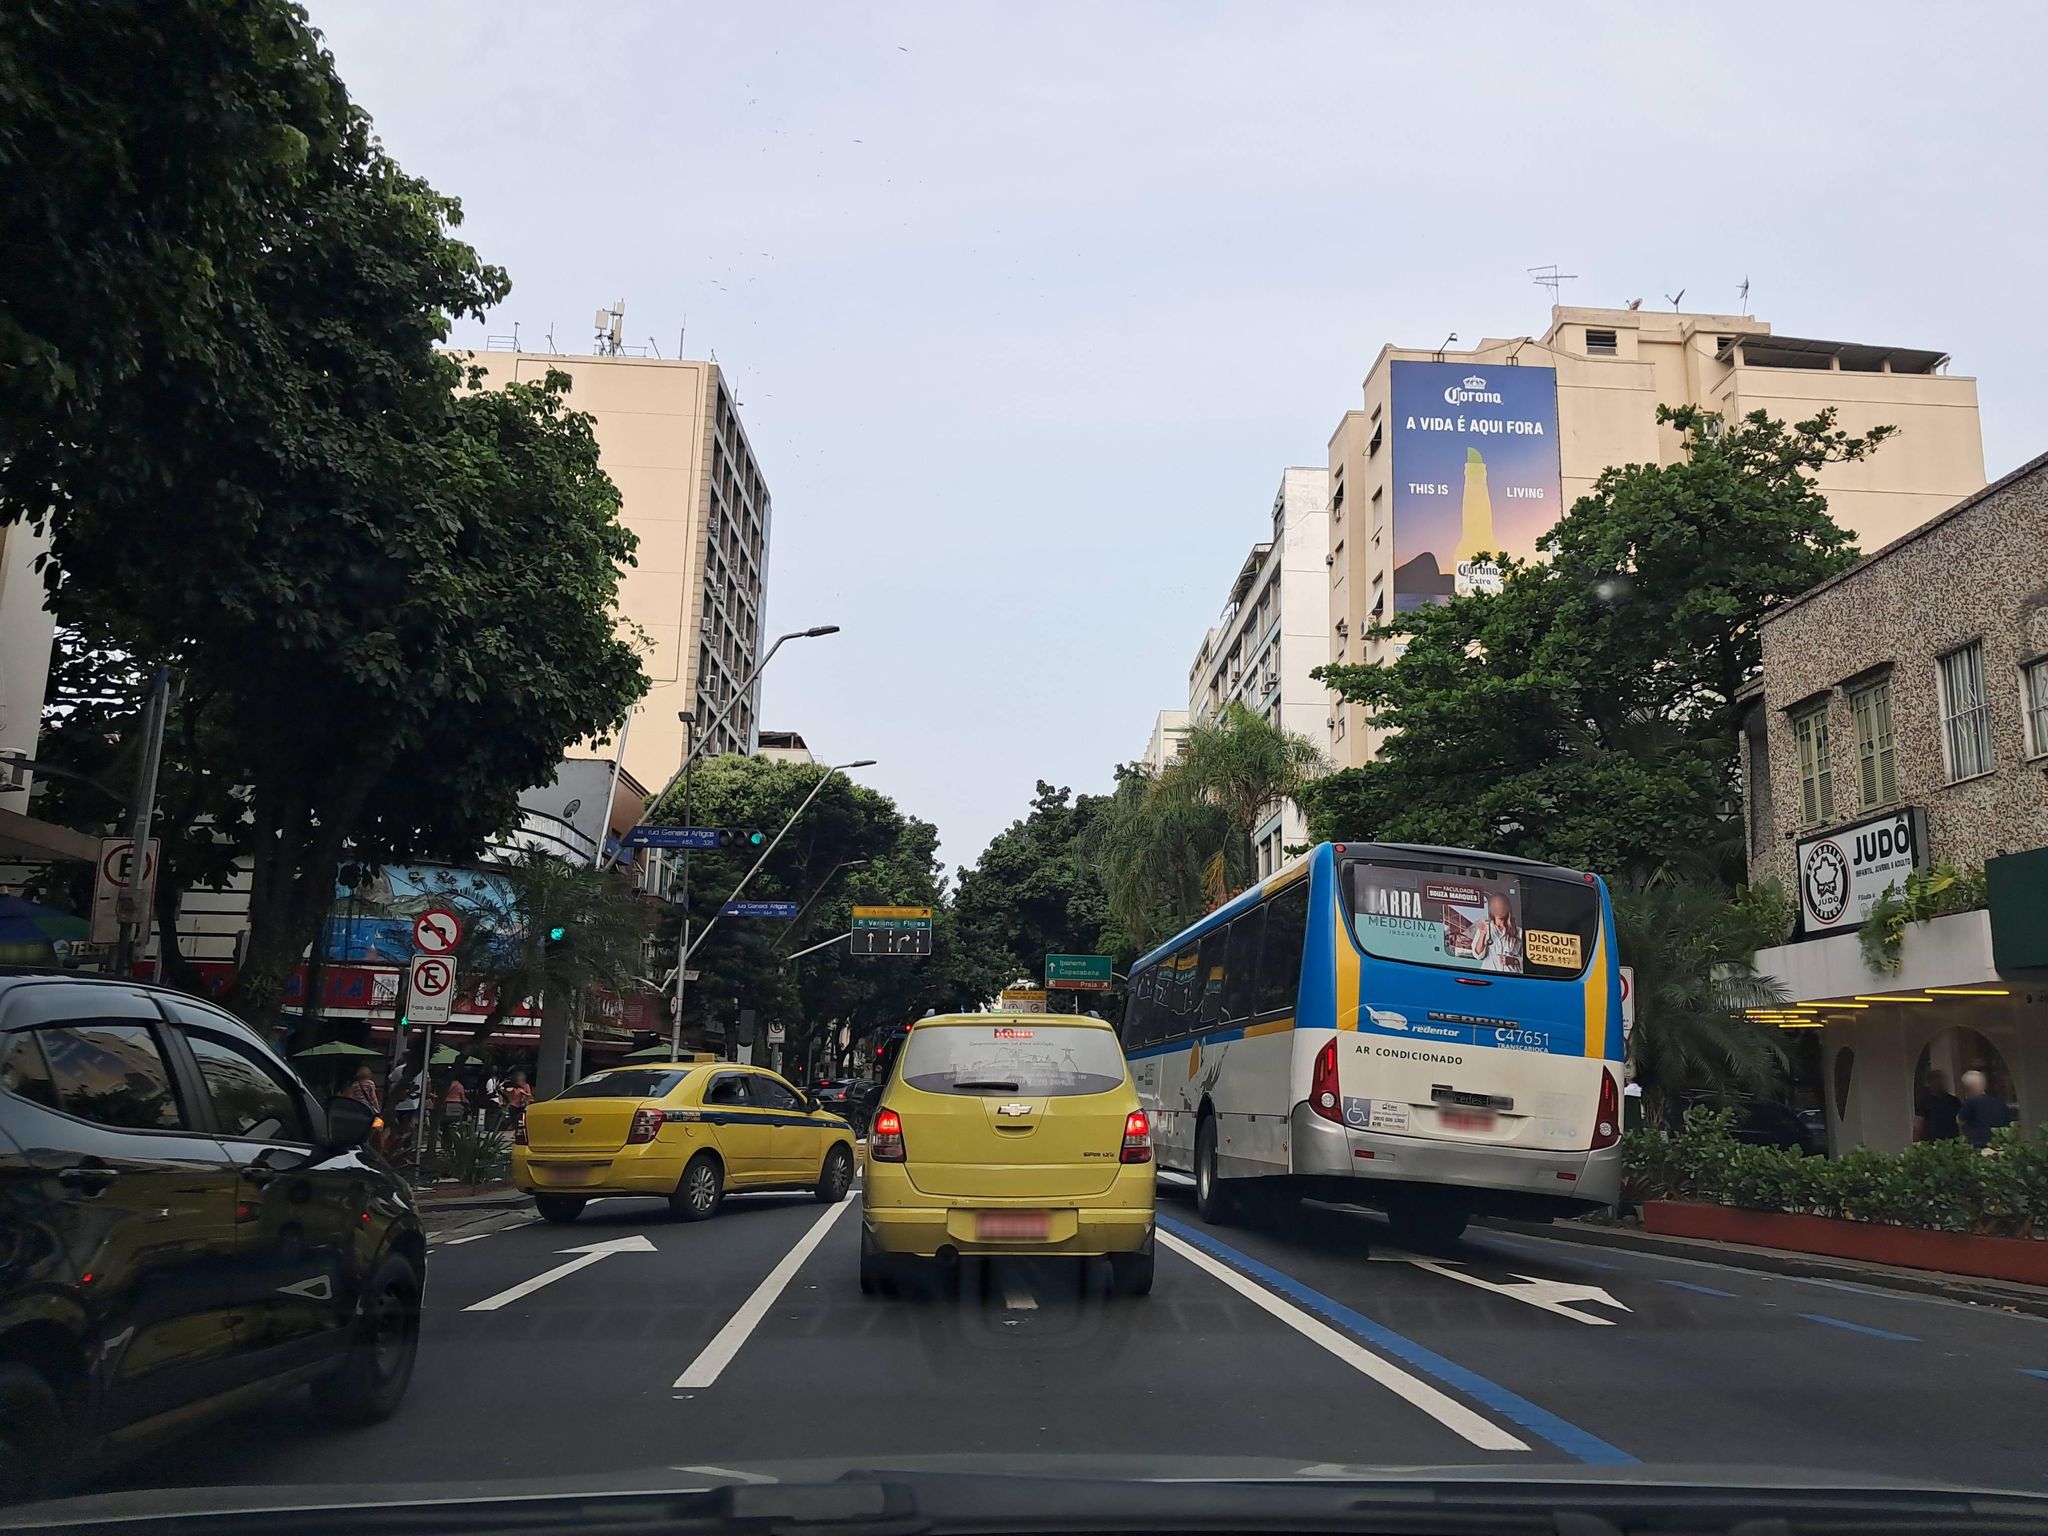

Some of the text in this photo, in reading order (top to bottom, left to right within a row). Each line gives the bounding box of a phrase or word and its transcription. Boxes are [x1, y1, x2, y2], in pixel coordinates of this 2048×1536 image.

[1444, 386, 1503, 406] Corona
[1406, 414, 1544, 435] A VIDA É AQUI FORA
[1409, 482, 1449, 495] THIS IS
[1506, 487, 1544, 499] LIVING
[1457, 562, 1498, 578] Corona
[1469, 575, 1491, 585] Extra
[661, 829, 689, 837] General
[691, 830, 715, 839] Artigas
[1429, 890, 1478, 901] SOUZA MARQUES
[1443, 886, 1475, 894] FACULDADE
[1368, 916, 1437, 932] MEDICINA
[1529, 933, 1577, 947] DISQUE
[1059, 969, 1100, 977] Copacabana
[1412, 1025, 1459, 1037] redentor
[1495, 1027, 1549, 1046] C47651
[1497, 1043, 1549, 1053] TRANSCARIOCA
[1356, 1045, 1463, 1065] AR CONDICIONADO
